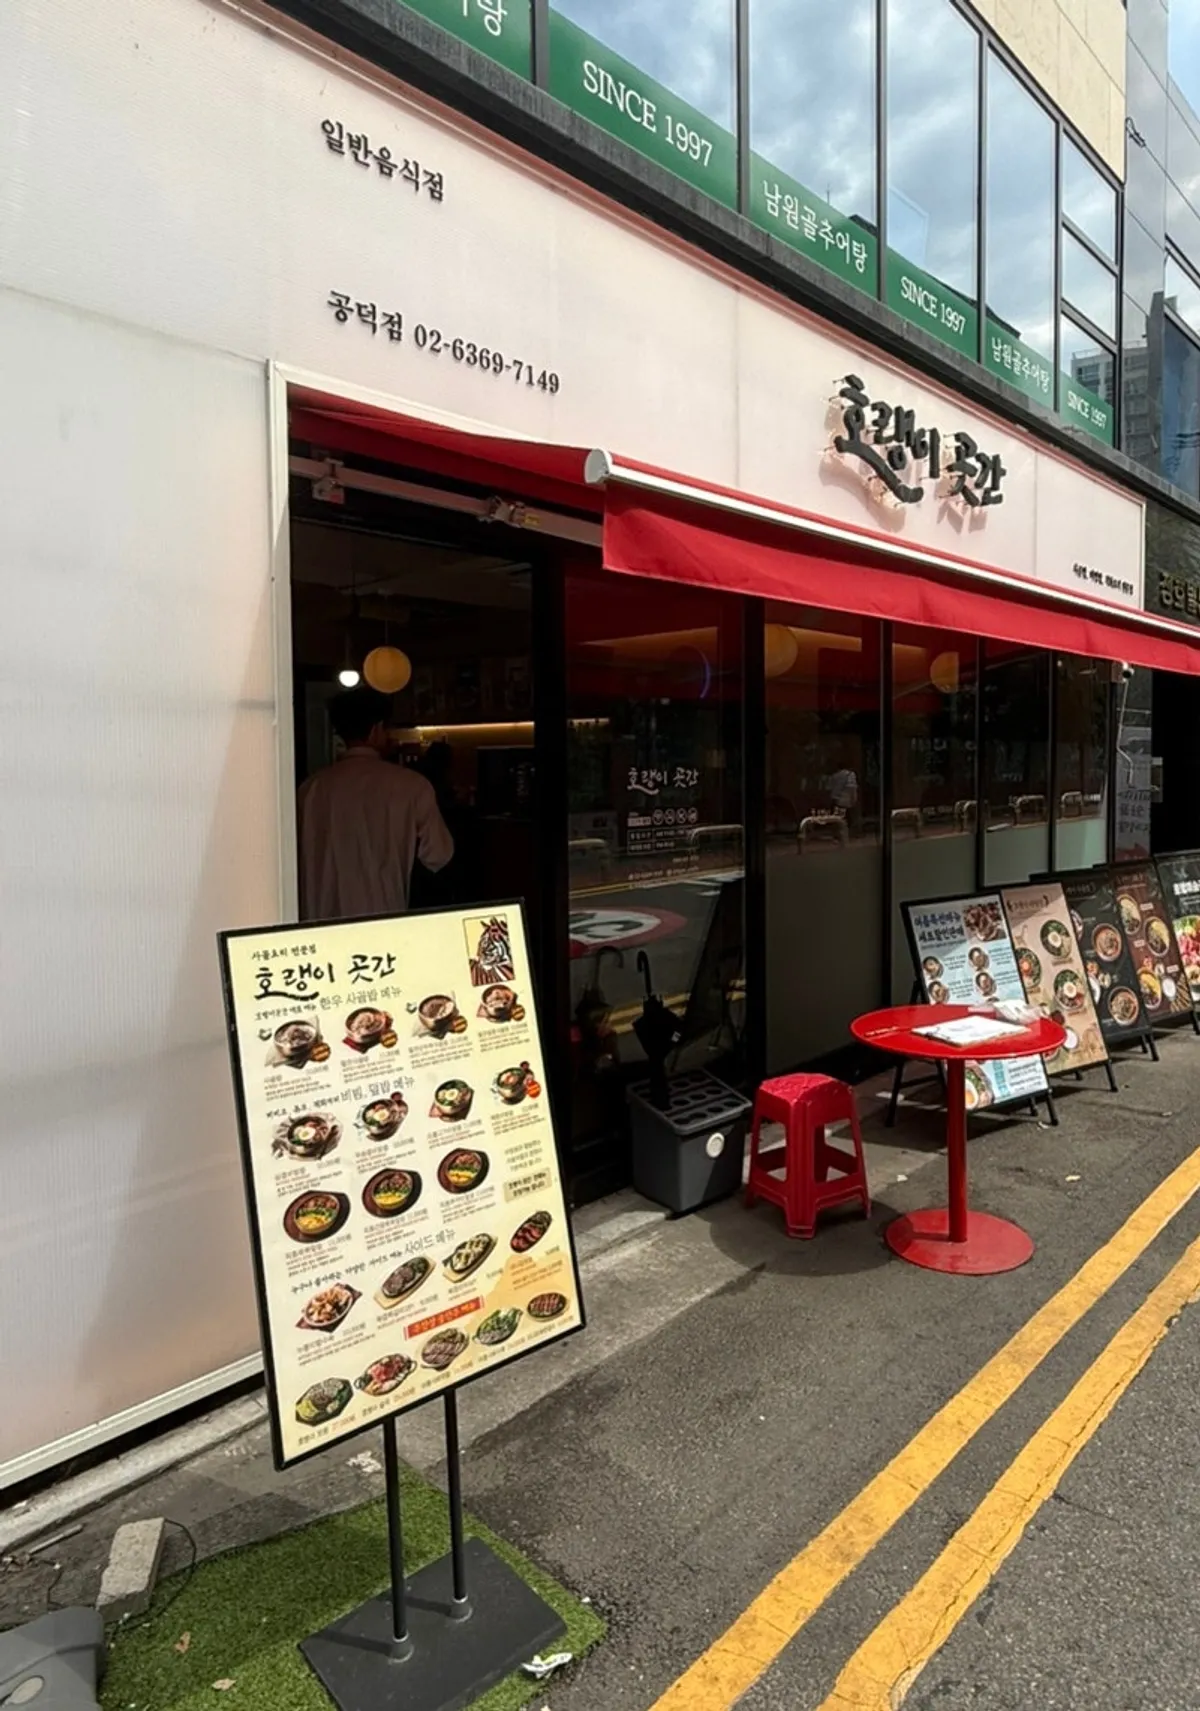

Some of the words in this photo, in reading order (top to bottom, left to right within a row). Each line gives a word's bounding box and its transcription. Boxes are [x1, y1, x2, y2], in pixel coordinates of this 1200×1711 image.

[583, 60, 657, 133] SINCE
[664, 115, 713, 167] 1997
[321, 118, 444, 202] 일반음식점
[762, 180, 867, 273] 남원골추어탕
[900, 275, 938, 317] SINCE
[940, 303, 966, 335] 1997
[327, 289, 402, 342] 공덕점
[413, 323, 559, 394] 02-6369-7149
[991, 336, 1050, 393] 남원골추어탕
[833, 373, 941, 504] 호랭이
[945, 431, 1007, 507] 곳간
[1067, 390, 1090, 418] SINCE
[1091, 405, 1107, 430] 1997
[627, 766, 668, 796] 호랭이
[673, 766, 699, 788] 곳간
[254, 963, 335, 1001] 호랭이
[348, 952, 396, 984] 곳간
[404, 1234, 435, 1255] 사이드
